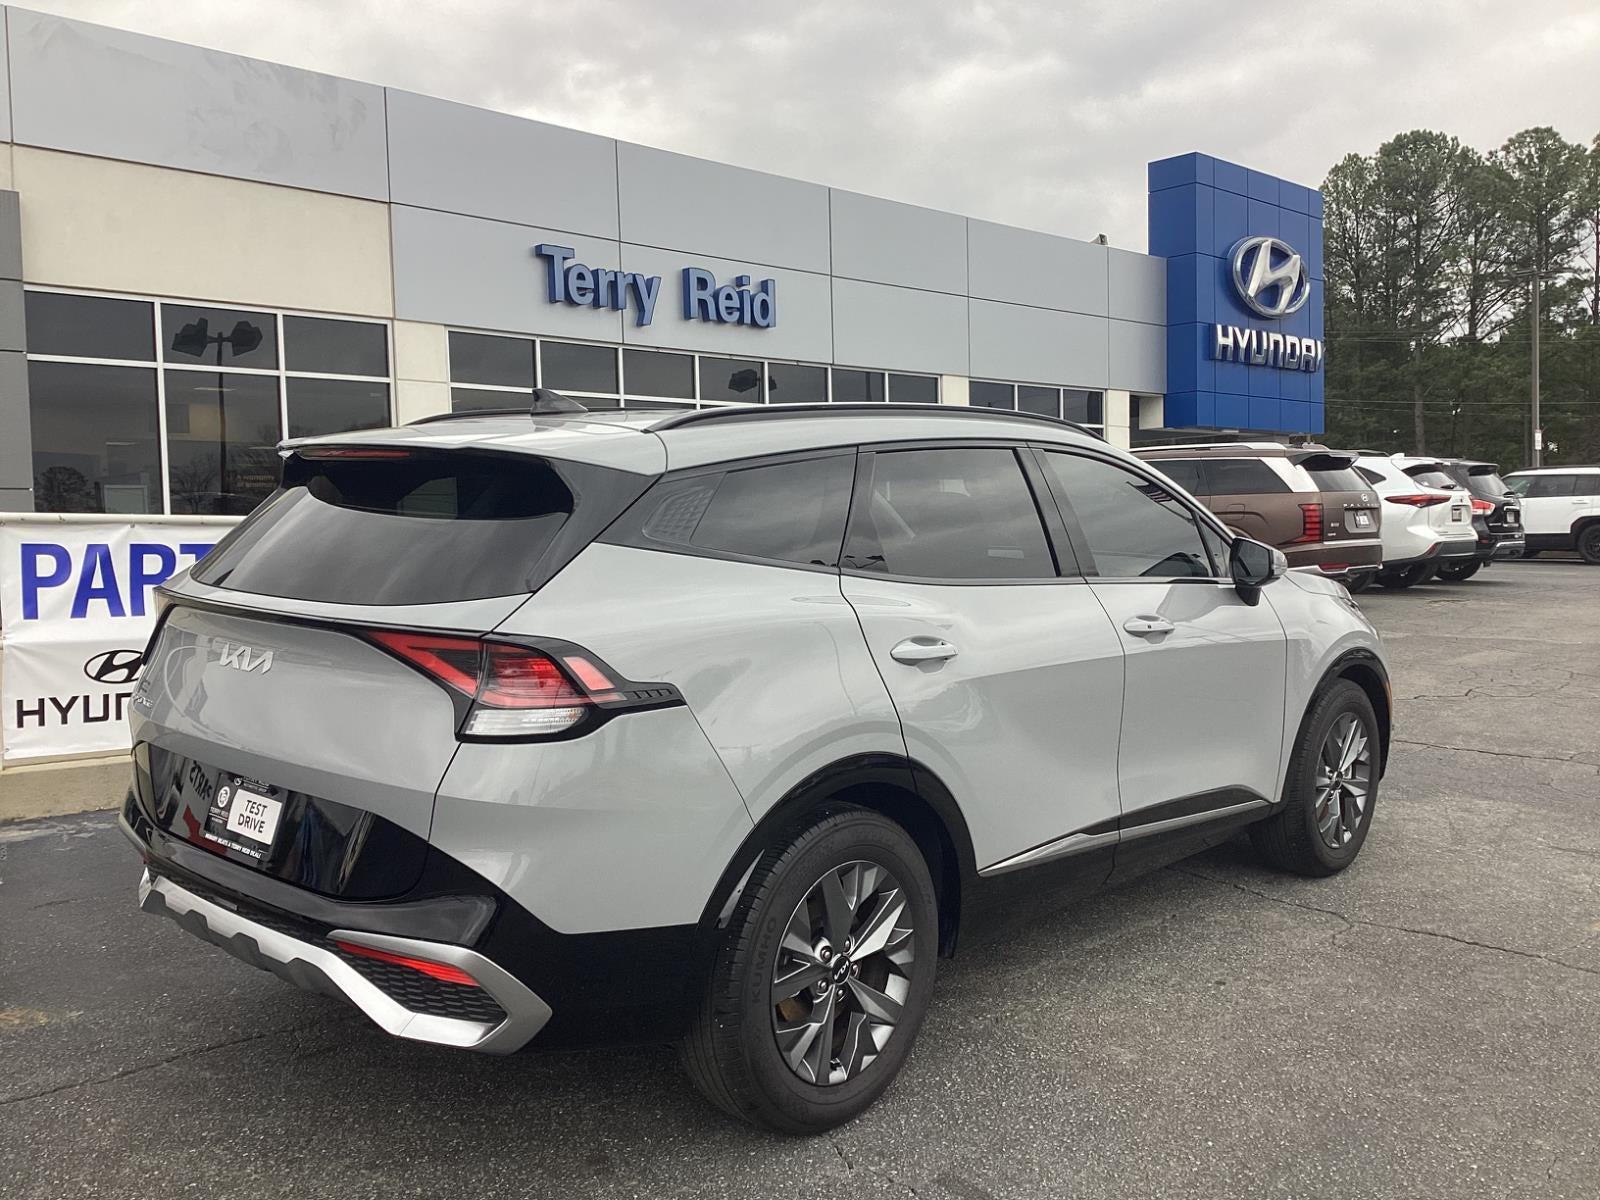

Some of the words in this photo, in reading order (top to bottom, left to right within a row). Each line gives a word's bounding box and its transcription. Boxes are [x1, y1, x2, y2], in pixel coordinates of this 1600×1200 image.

[535, 244, 661, 327] Terry
[682, 267, 776, 328] Reid
[1214, 324, 1325, 372] HYUNDAI
[218, 646, 274, 675] KIA
[238, 813, 266, 833] DRIVE
[245, 800, 268, 818] TEST
